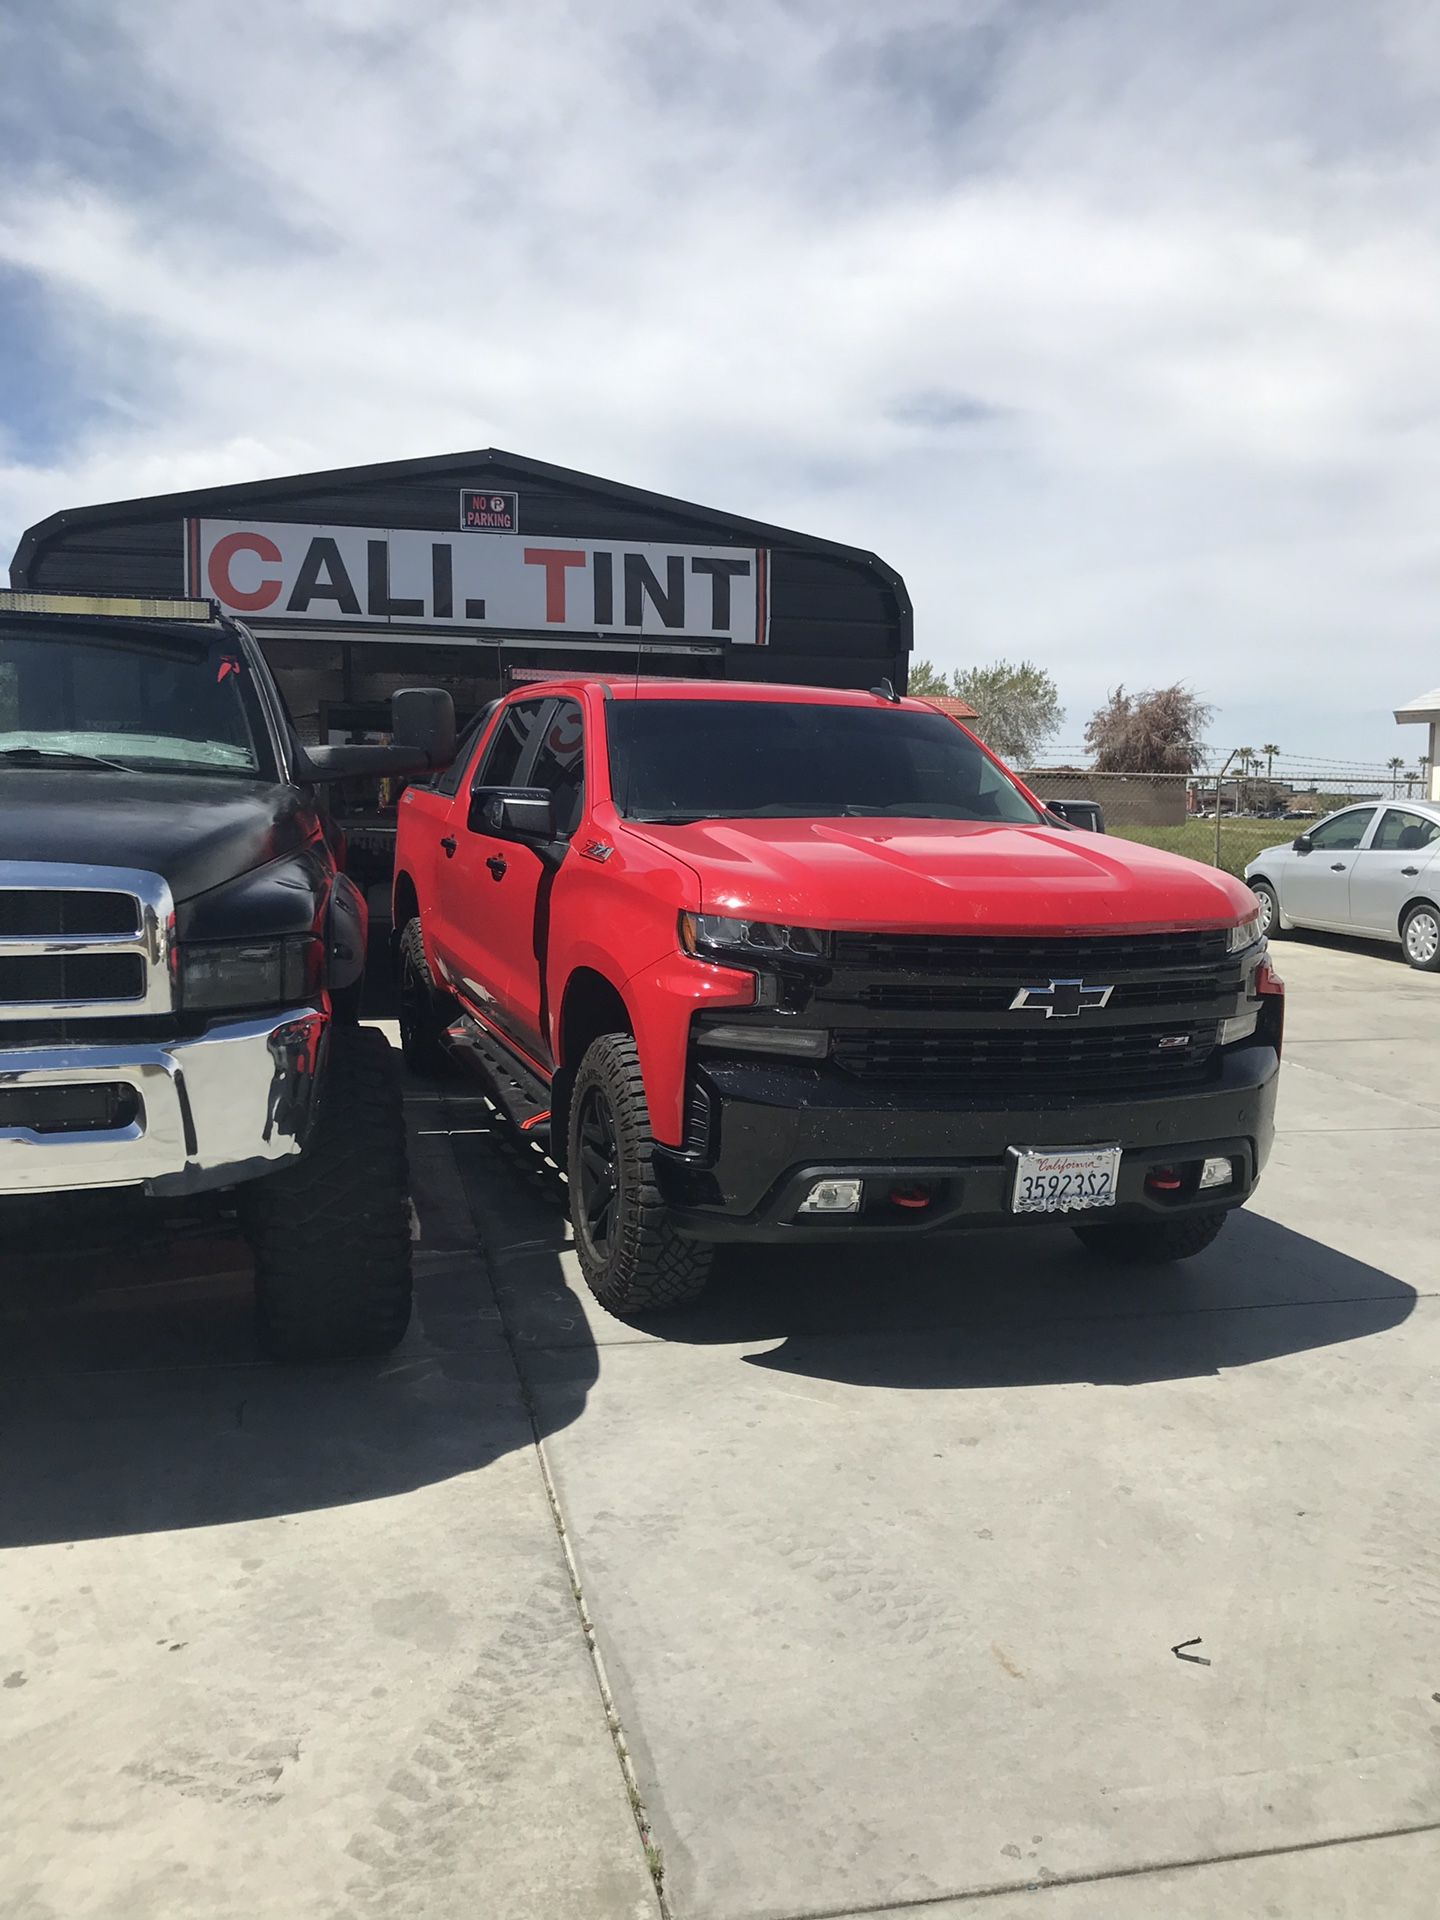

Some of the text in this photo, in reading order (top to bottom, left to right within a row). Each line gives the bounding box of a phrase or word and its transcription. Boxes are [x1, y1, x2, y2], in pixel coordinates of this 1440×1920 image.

[472, 496, 487, 510] NO
[467, 512, 511, 528] PARKING
[208, 531, 751, 631] CALI. TINT
[1037, 1158, 1101, 1174] California
